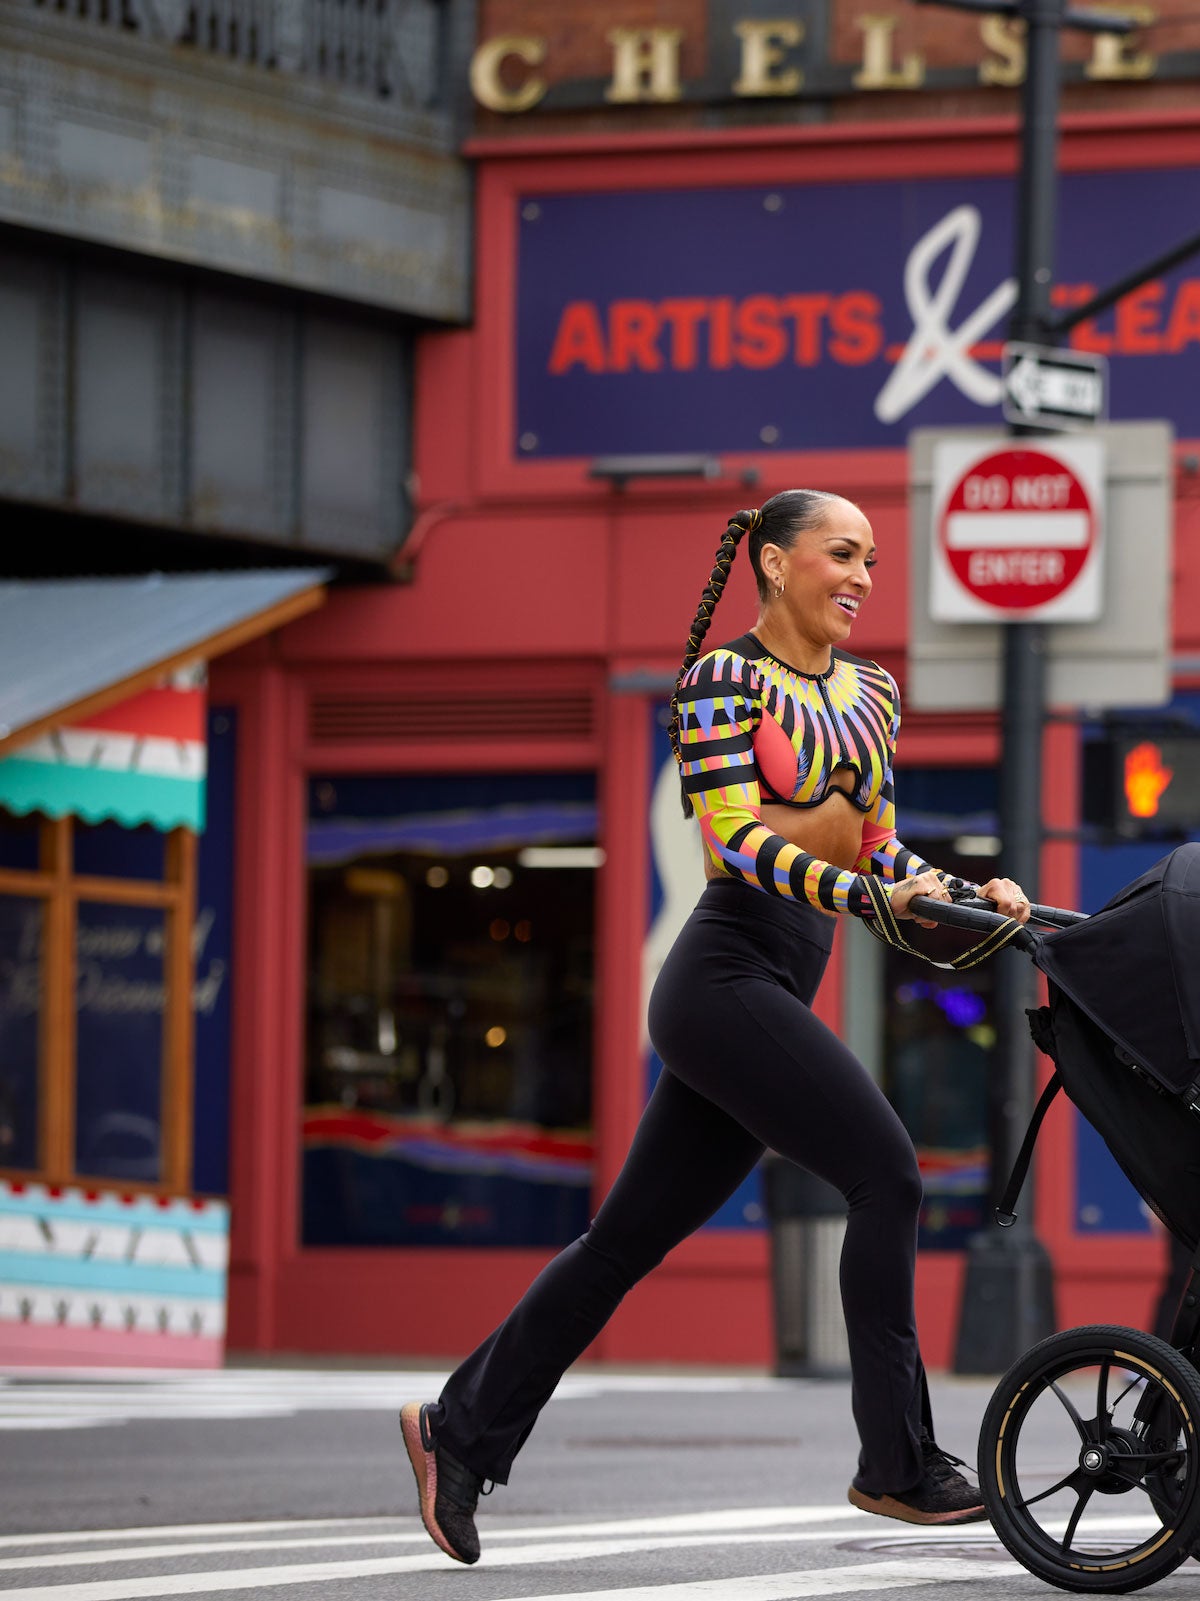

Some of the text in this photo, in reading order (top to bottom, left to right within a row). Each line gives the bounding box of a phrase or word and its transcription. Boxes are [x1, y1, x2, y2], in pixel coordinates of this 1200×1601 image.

[548, 291, 880, 374] ARTISTS
[876, 203, 1018, 424] &
[964, 473, 1073, 509] DO NOT
[968, 552, 1065, 586] ENTER
